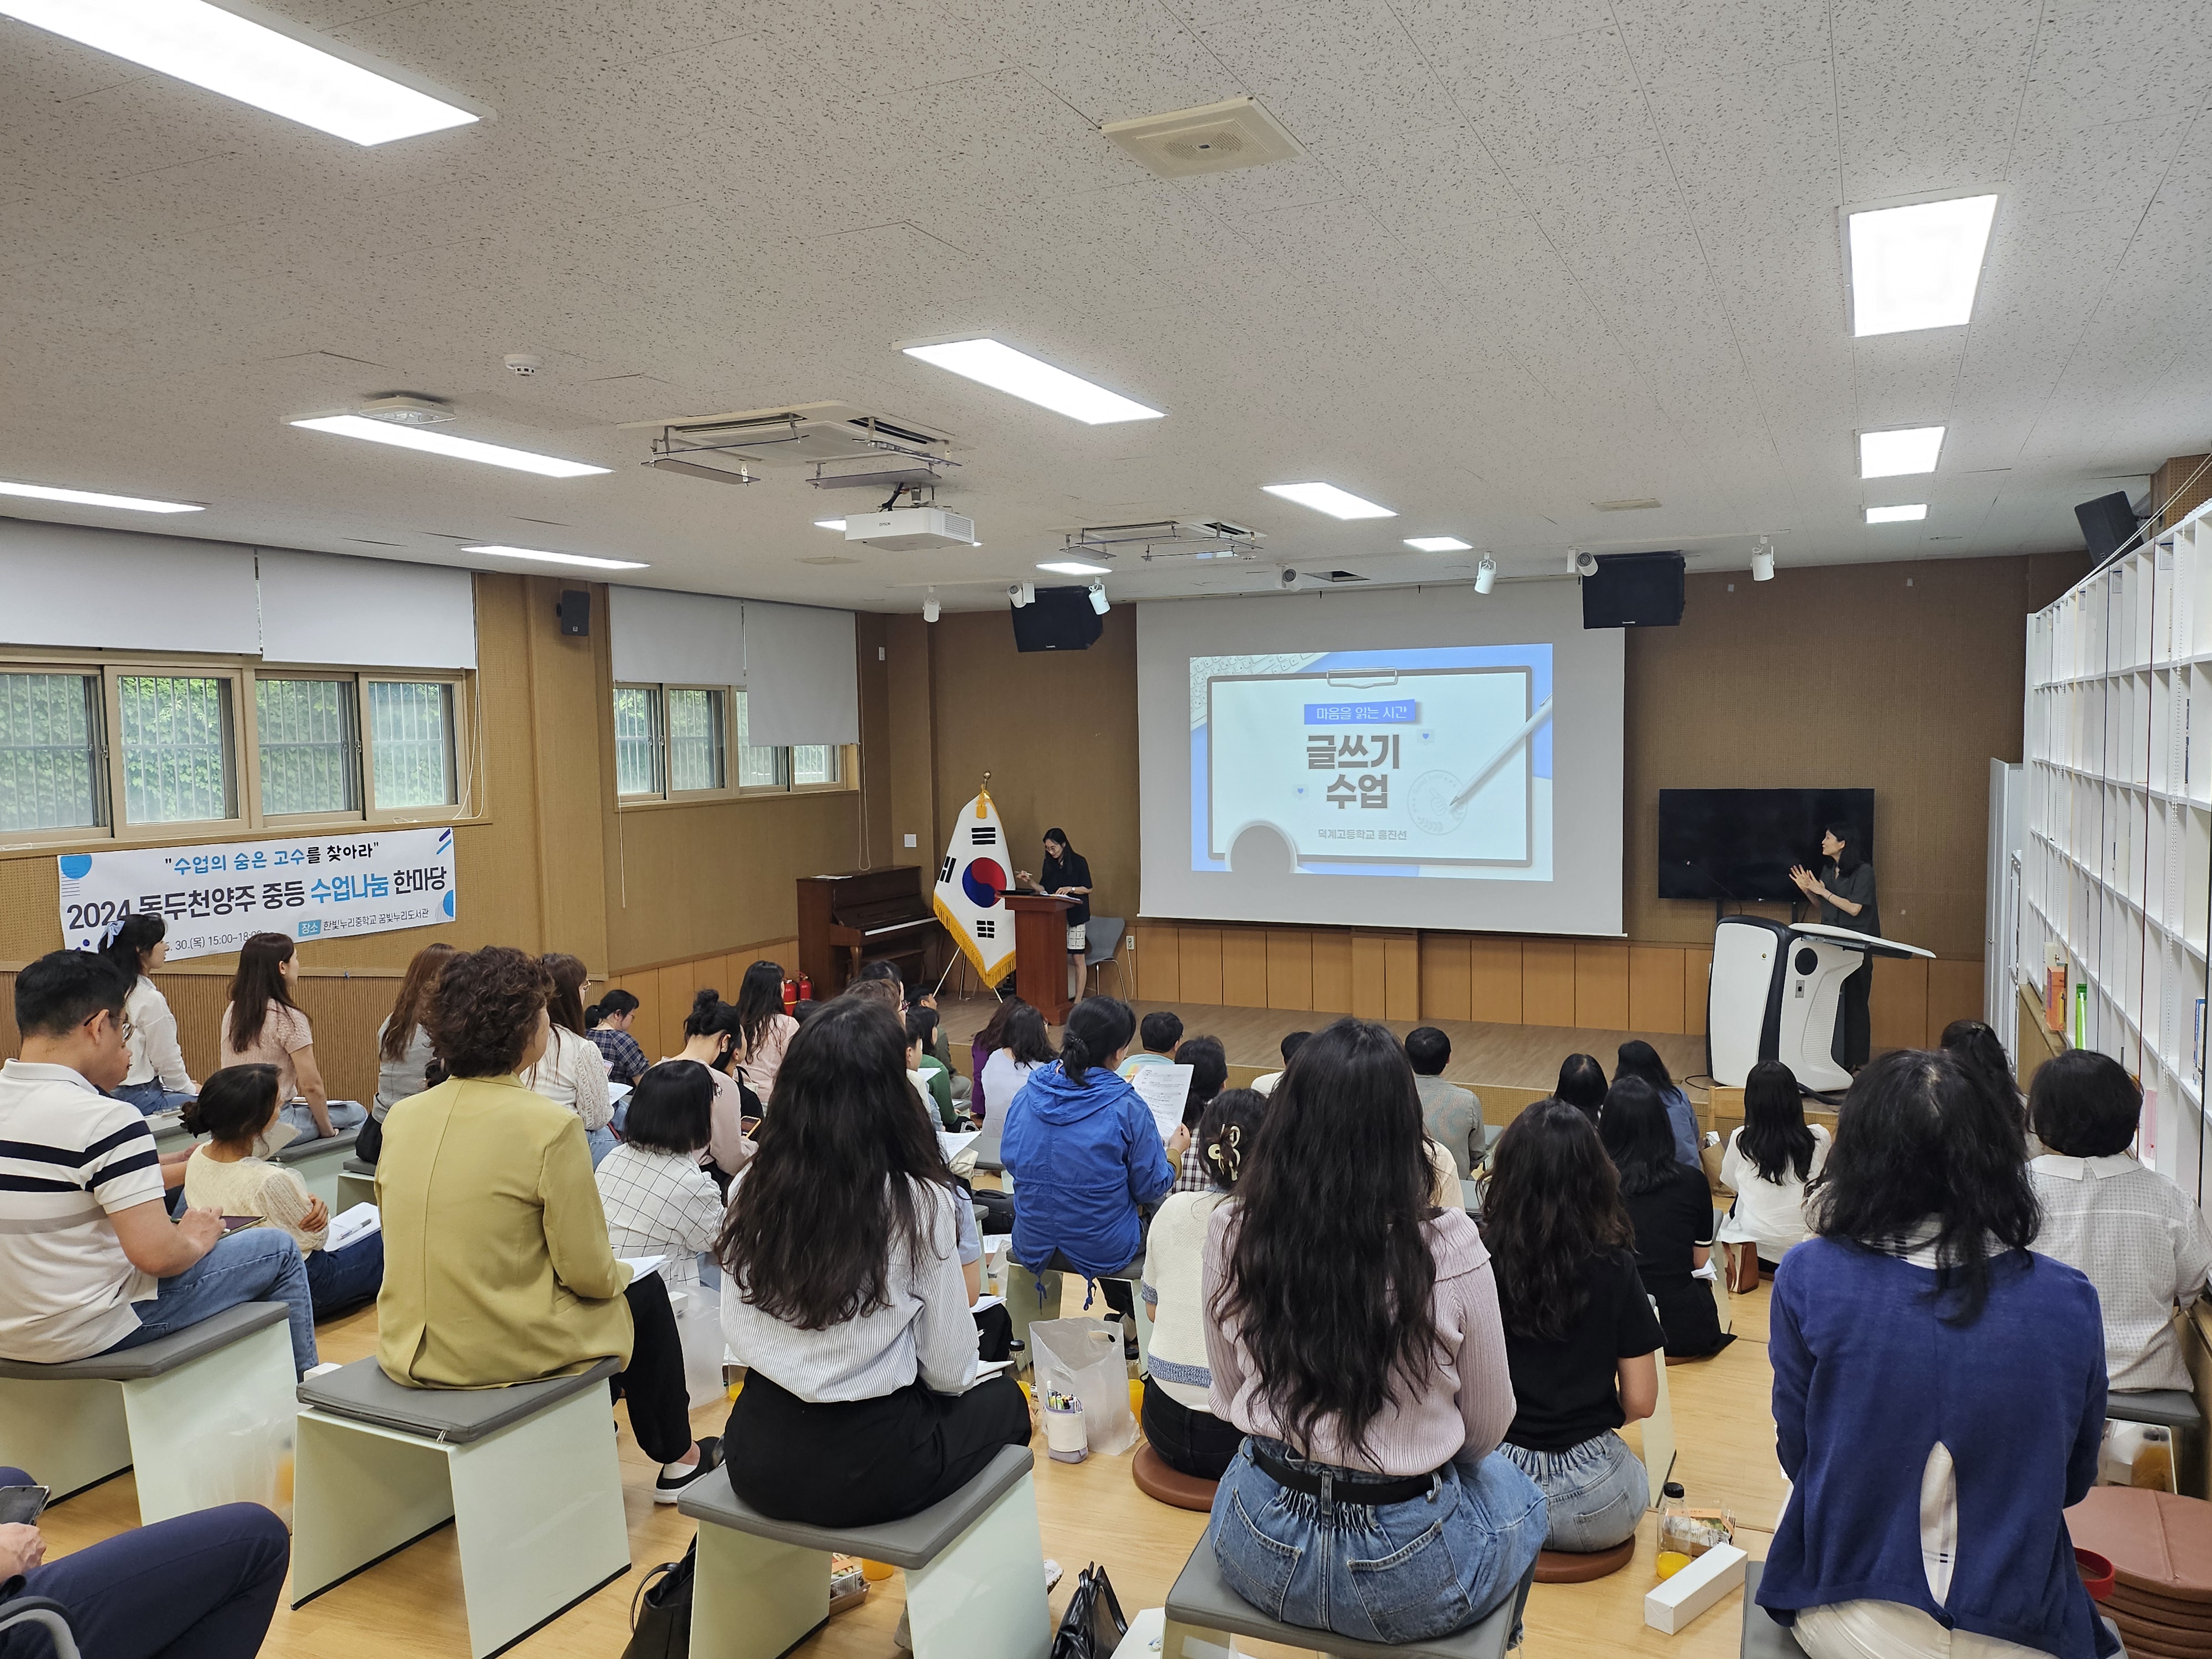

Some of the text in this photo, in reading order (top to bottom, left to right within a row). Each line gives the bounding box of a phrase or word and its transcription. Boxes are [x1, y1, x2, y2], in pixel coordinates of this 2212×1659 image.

[1316, 706, 1407, 720] 마음을 읽는 시간
[1307, 734, 1400, 769] 글쓰기
[1327, 774, 1387, 809] 수업
[1318, 829, 1375, 839] 덕계고등학교
[165, 842, 379, 875] "수업의 숨은 고수를 찾아라"
[262, 880, 305, 909] 중등
[311, 873, 389, 904] 수업나눔
[393, 866, 447, 895] 한마당
[301, 922, 319, 934] 장소
[324, 908, 429, 931] 한빛누리중학교 꿈빛누리도서관
